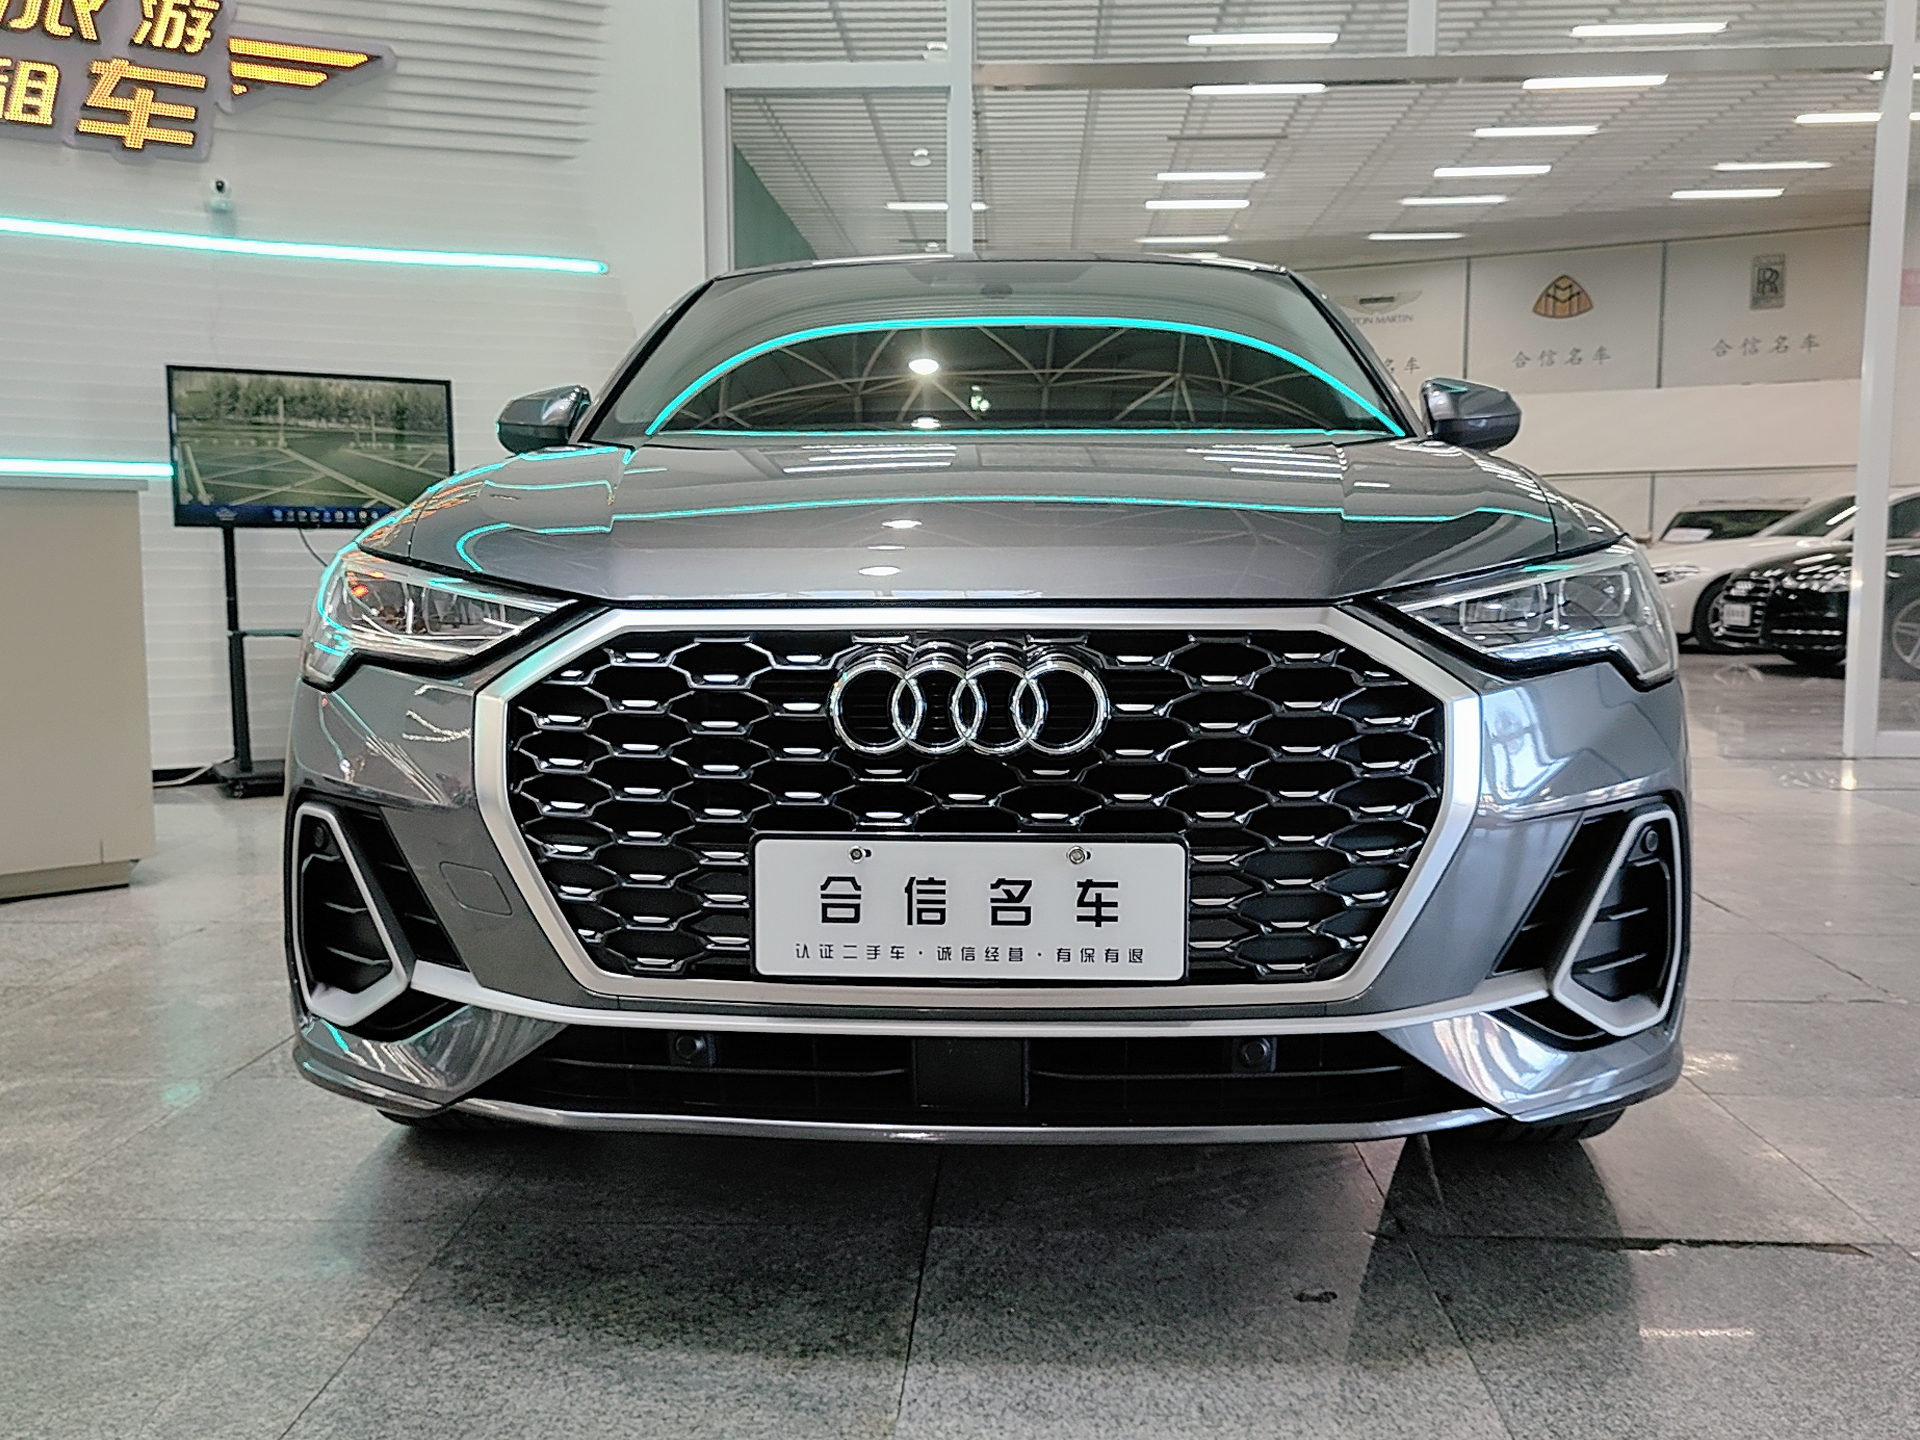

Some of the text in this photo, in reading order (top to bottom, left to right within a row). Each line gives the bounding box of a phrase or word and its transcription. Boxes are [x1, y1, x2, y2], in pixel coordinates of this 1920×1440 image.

[1351, 314, 1414, 325] TON MARTIN
[1512, 345, 1611, 369] 合信名车
[1712, 333, 1820, 358] 合信名车
[820, 876, 1119, 927] 合信名车
